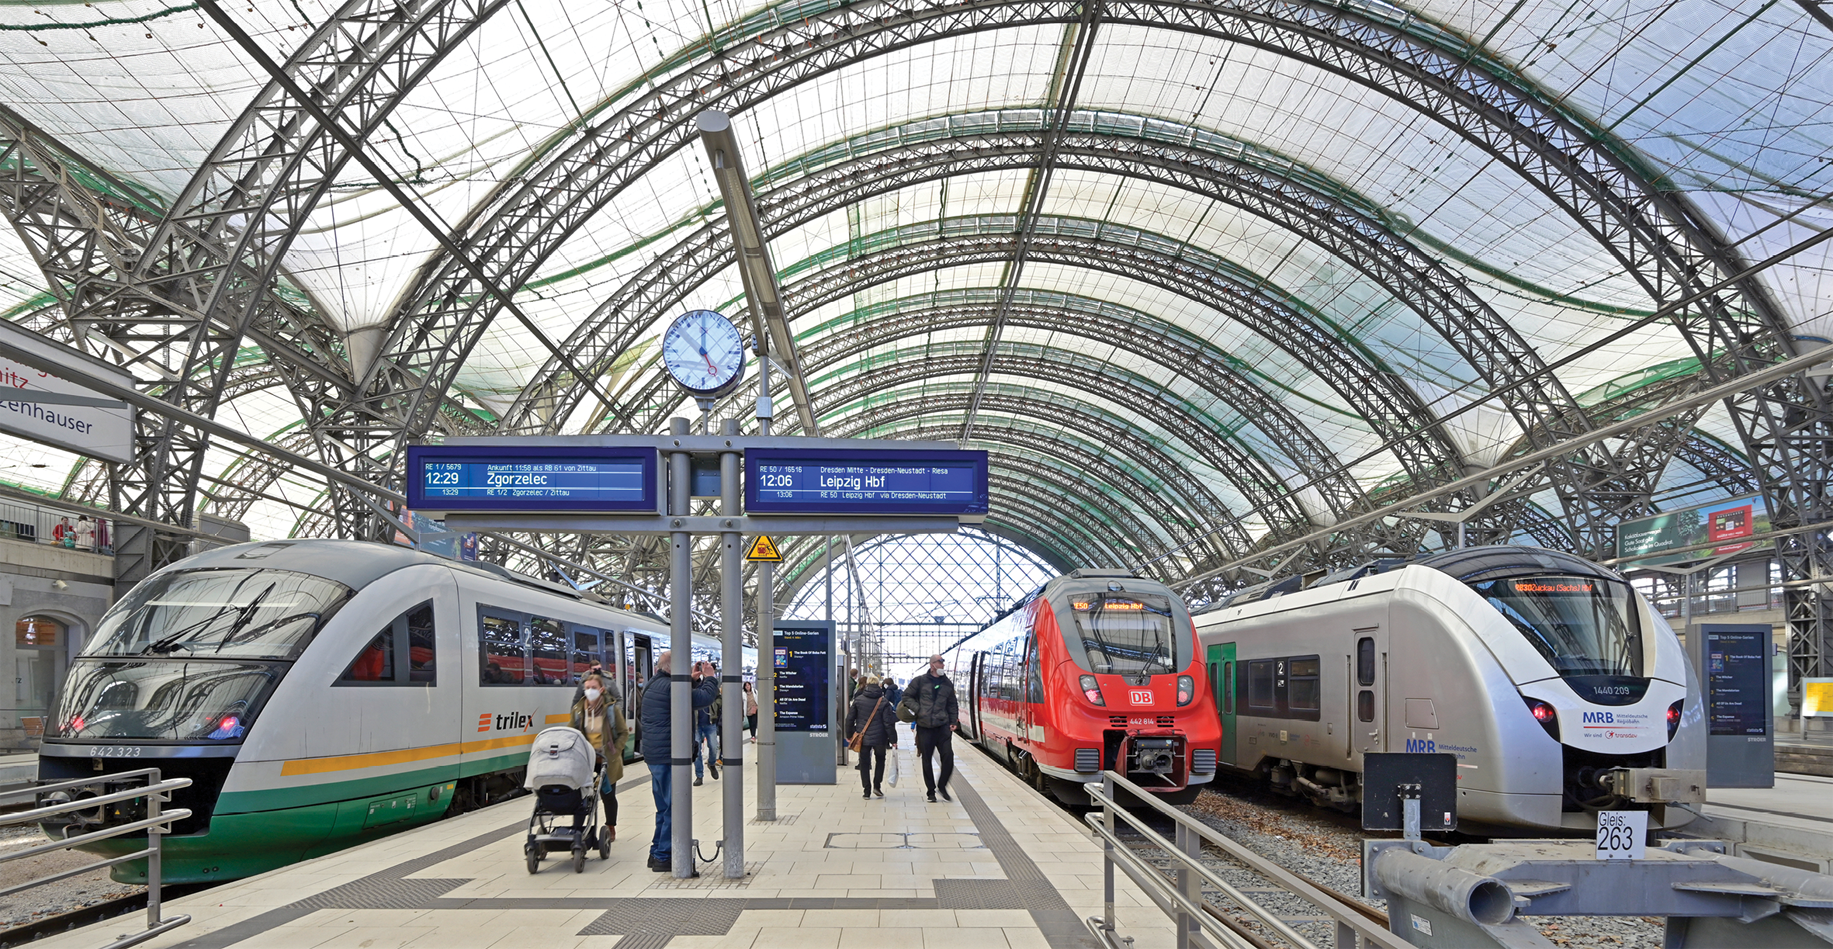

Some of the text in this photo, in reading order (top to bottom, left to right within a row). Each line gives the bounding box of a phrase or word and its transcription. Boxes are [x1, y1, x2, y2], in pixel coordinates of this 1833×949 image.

[0, 367, 28, 390] itz
[425, 472, 459, 484] 12:29
[487, 472, 547, 487] Zgorzelec
[760, 474, 793, 487] 12:06
[821, 475, 885, 490] Leipzig Hbf
[512, 489, 543, 497] Zgorzelec
[524, 627, 531, 647] 2
[1278, 662, 1284, 674] 2
[1593, 686, 1630, 695] 1440 209
[1132, 692, 1152, 703] DB
[496, 709, 538, 732] trilex
[1583, 712, 1614, 723] MRB
[90, 746, 141, 757] 642 323
[1406, 739, 1436, 753] MRB
[1439, 744, 1477, 753] Mitteldeutsche
[1599, 812, 1626, 827] Gleis:
[1597, 826, 1633, 850] 263
